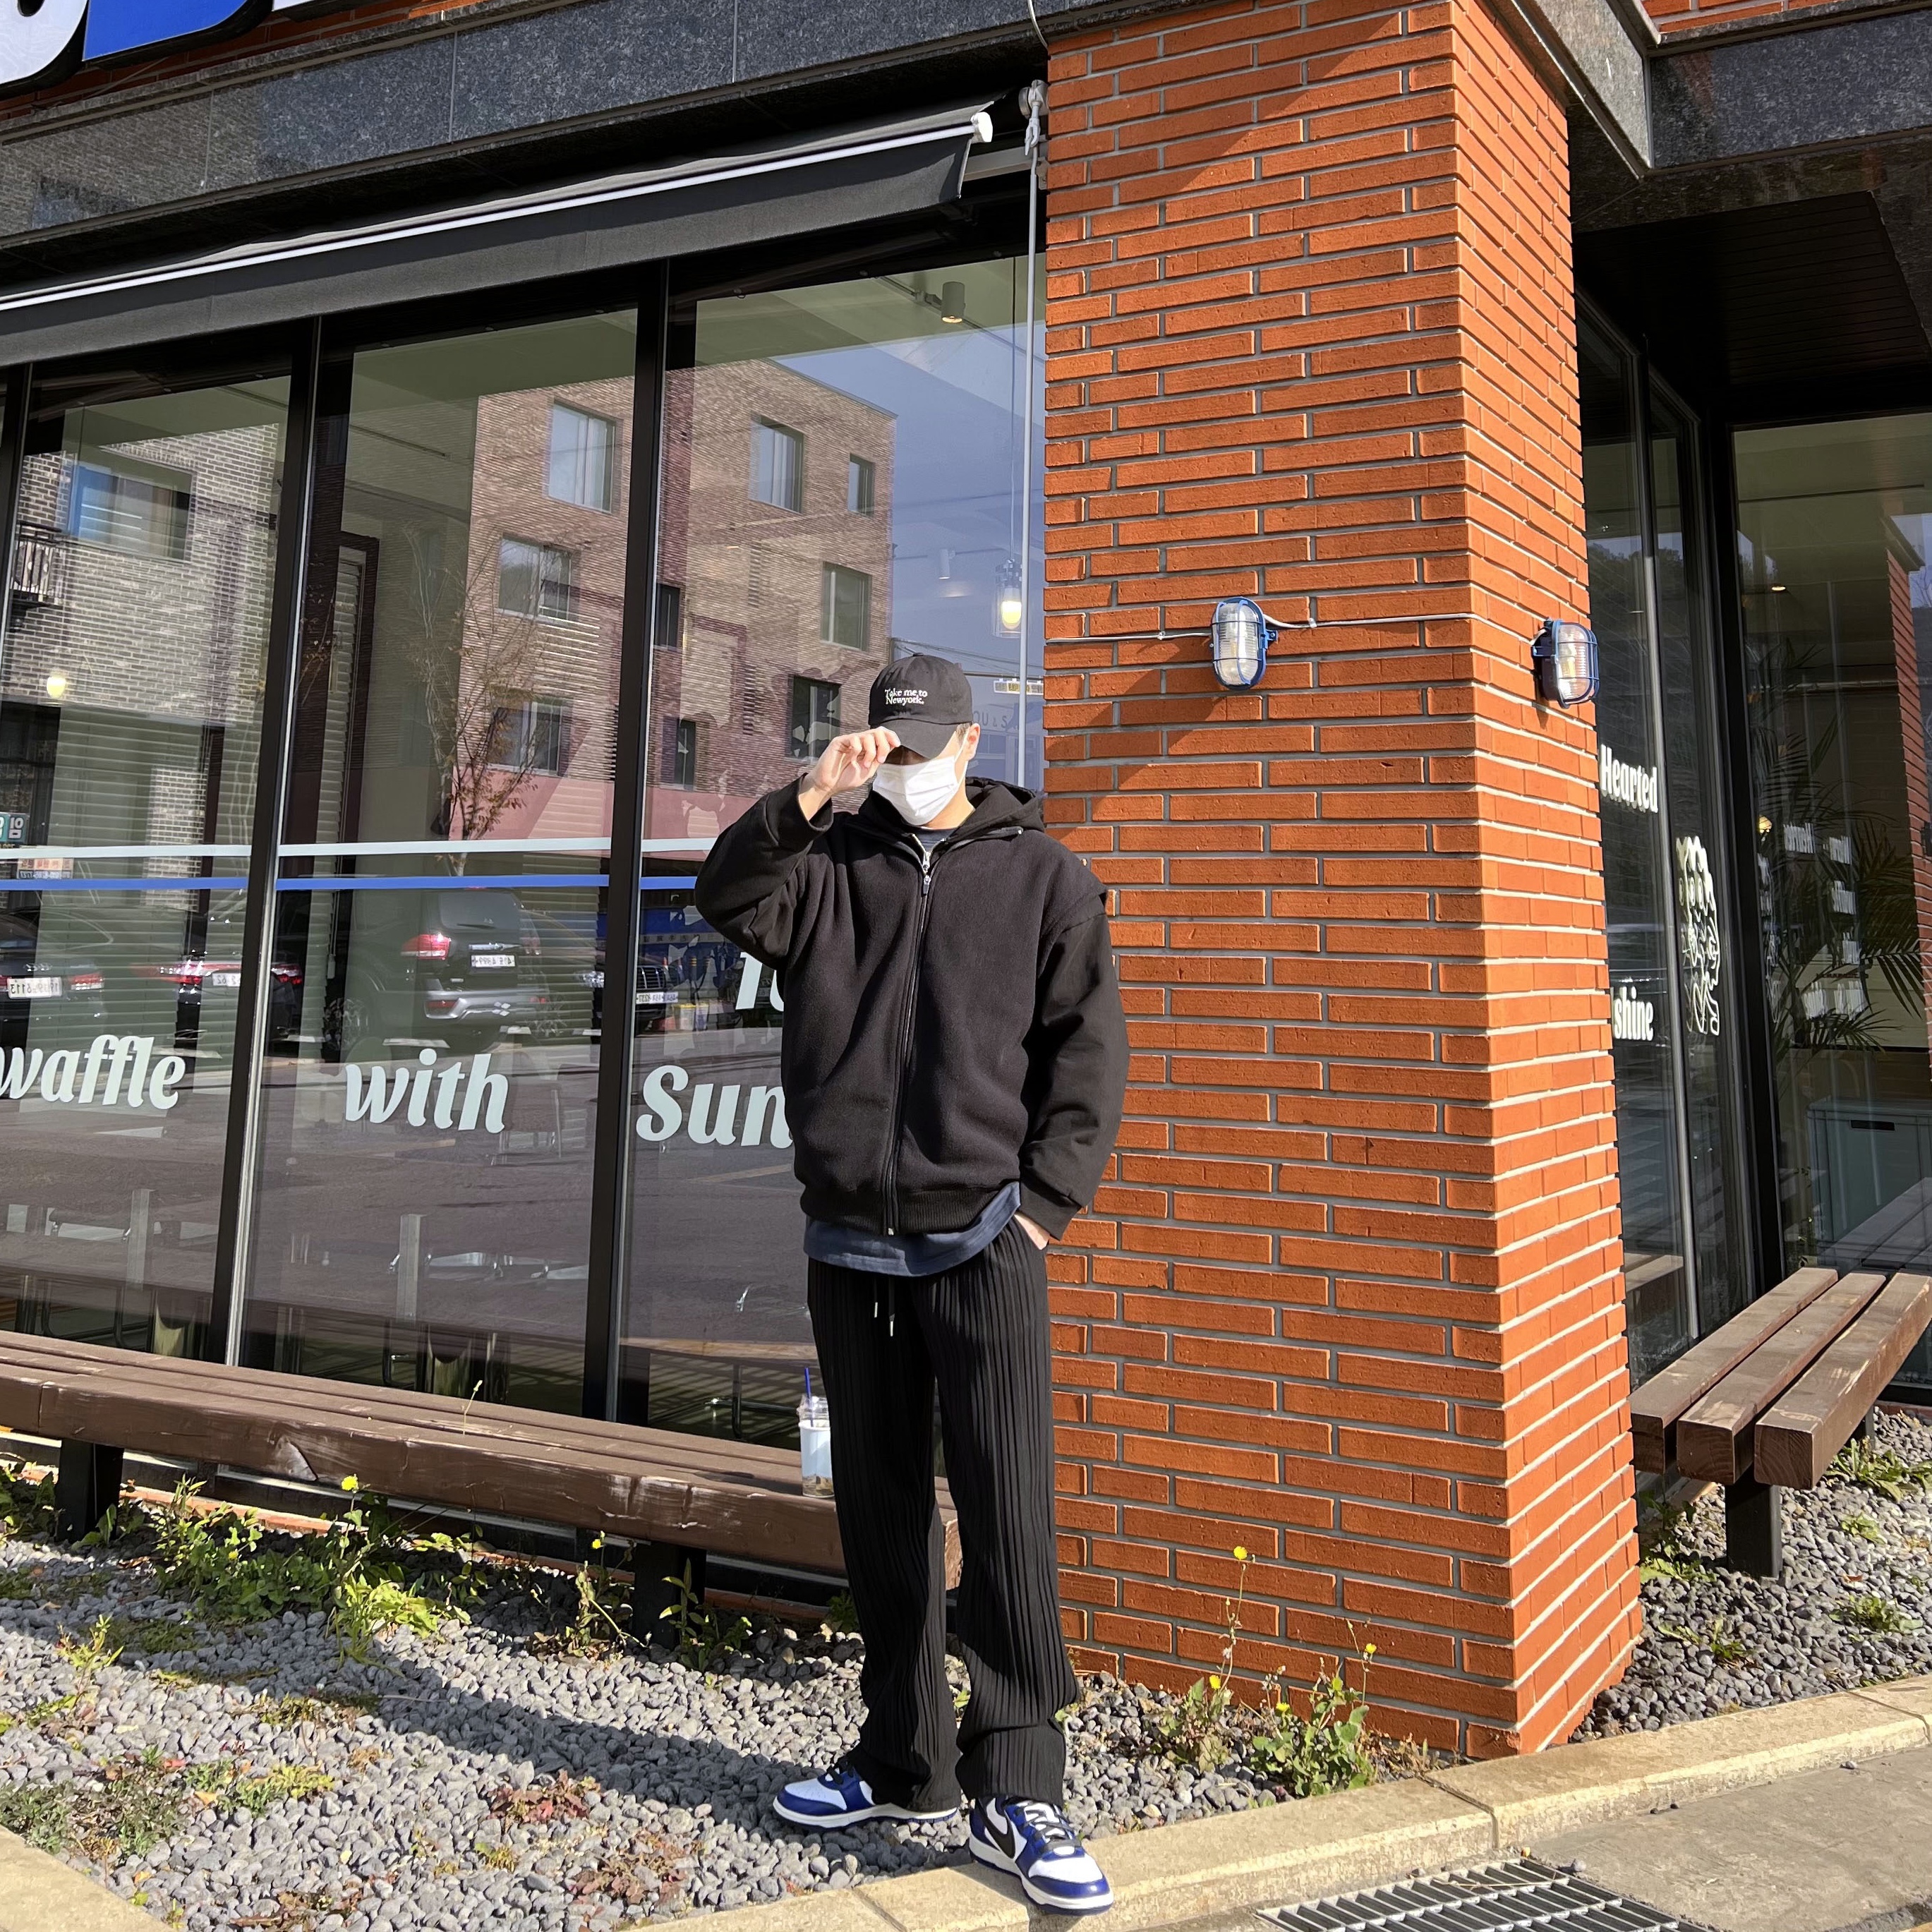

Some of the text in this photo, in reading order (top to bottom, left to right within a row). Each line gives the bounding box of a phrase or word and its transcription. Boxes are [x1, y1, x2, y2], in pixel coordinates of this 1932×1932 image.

[884, 688, 902, 697] Take
[886, 695, 924, 706] Newyork.
[1601, 744, 1658, 813] Hearted
[1614, 986, 1653, 1041] shine
[0, 1034, 186, 1110] waffle
[345, 1048, 508, 1133] with
